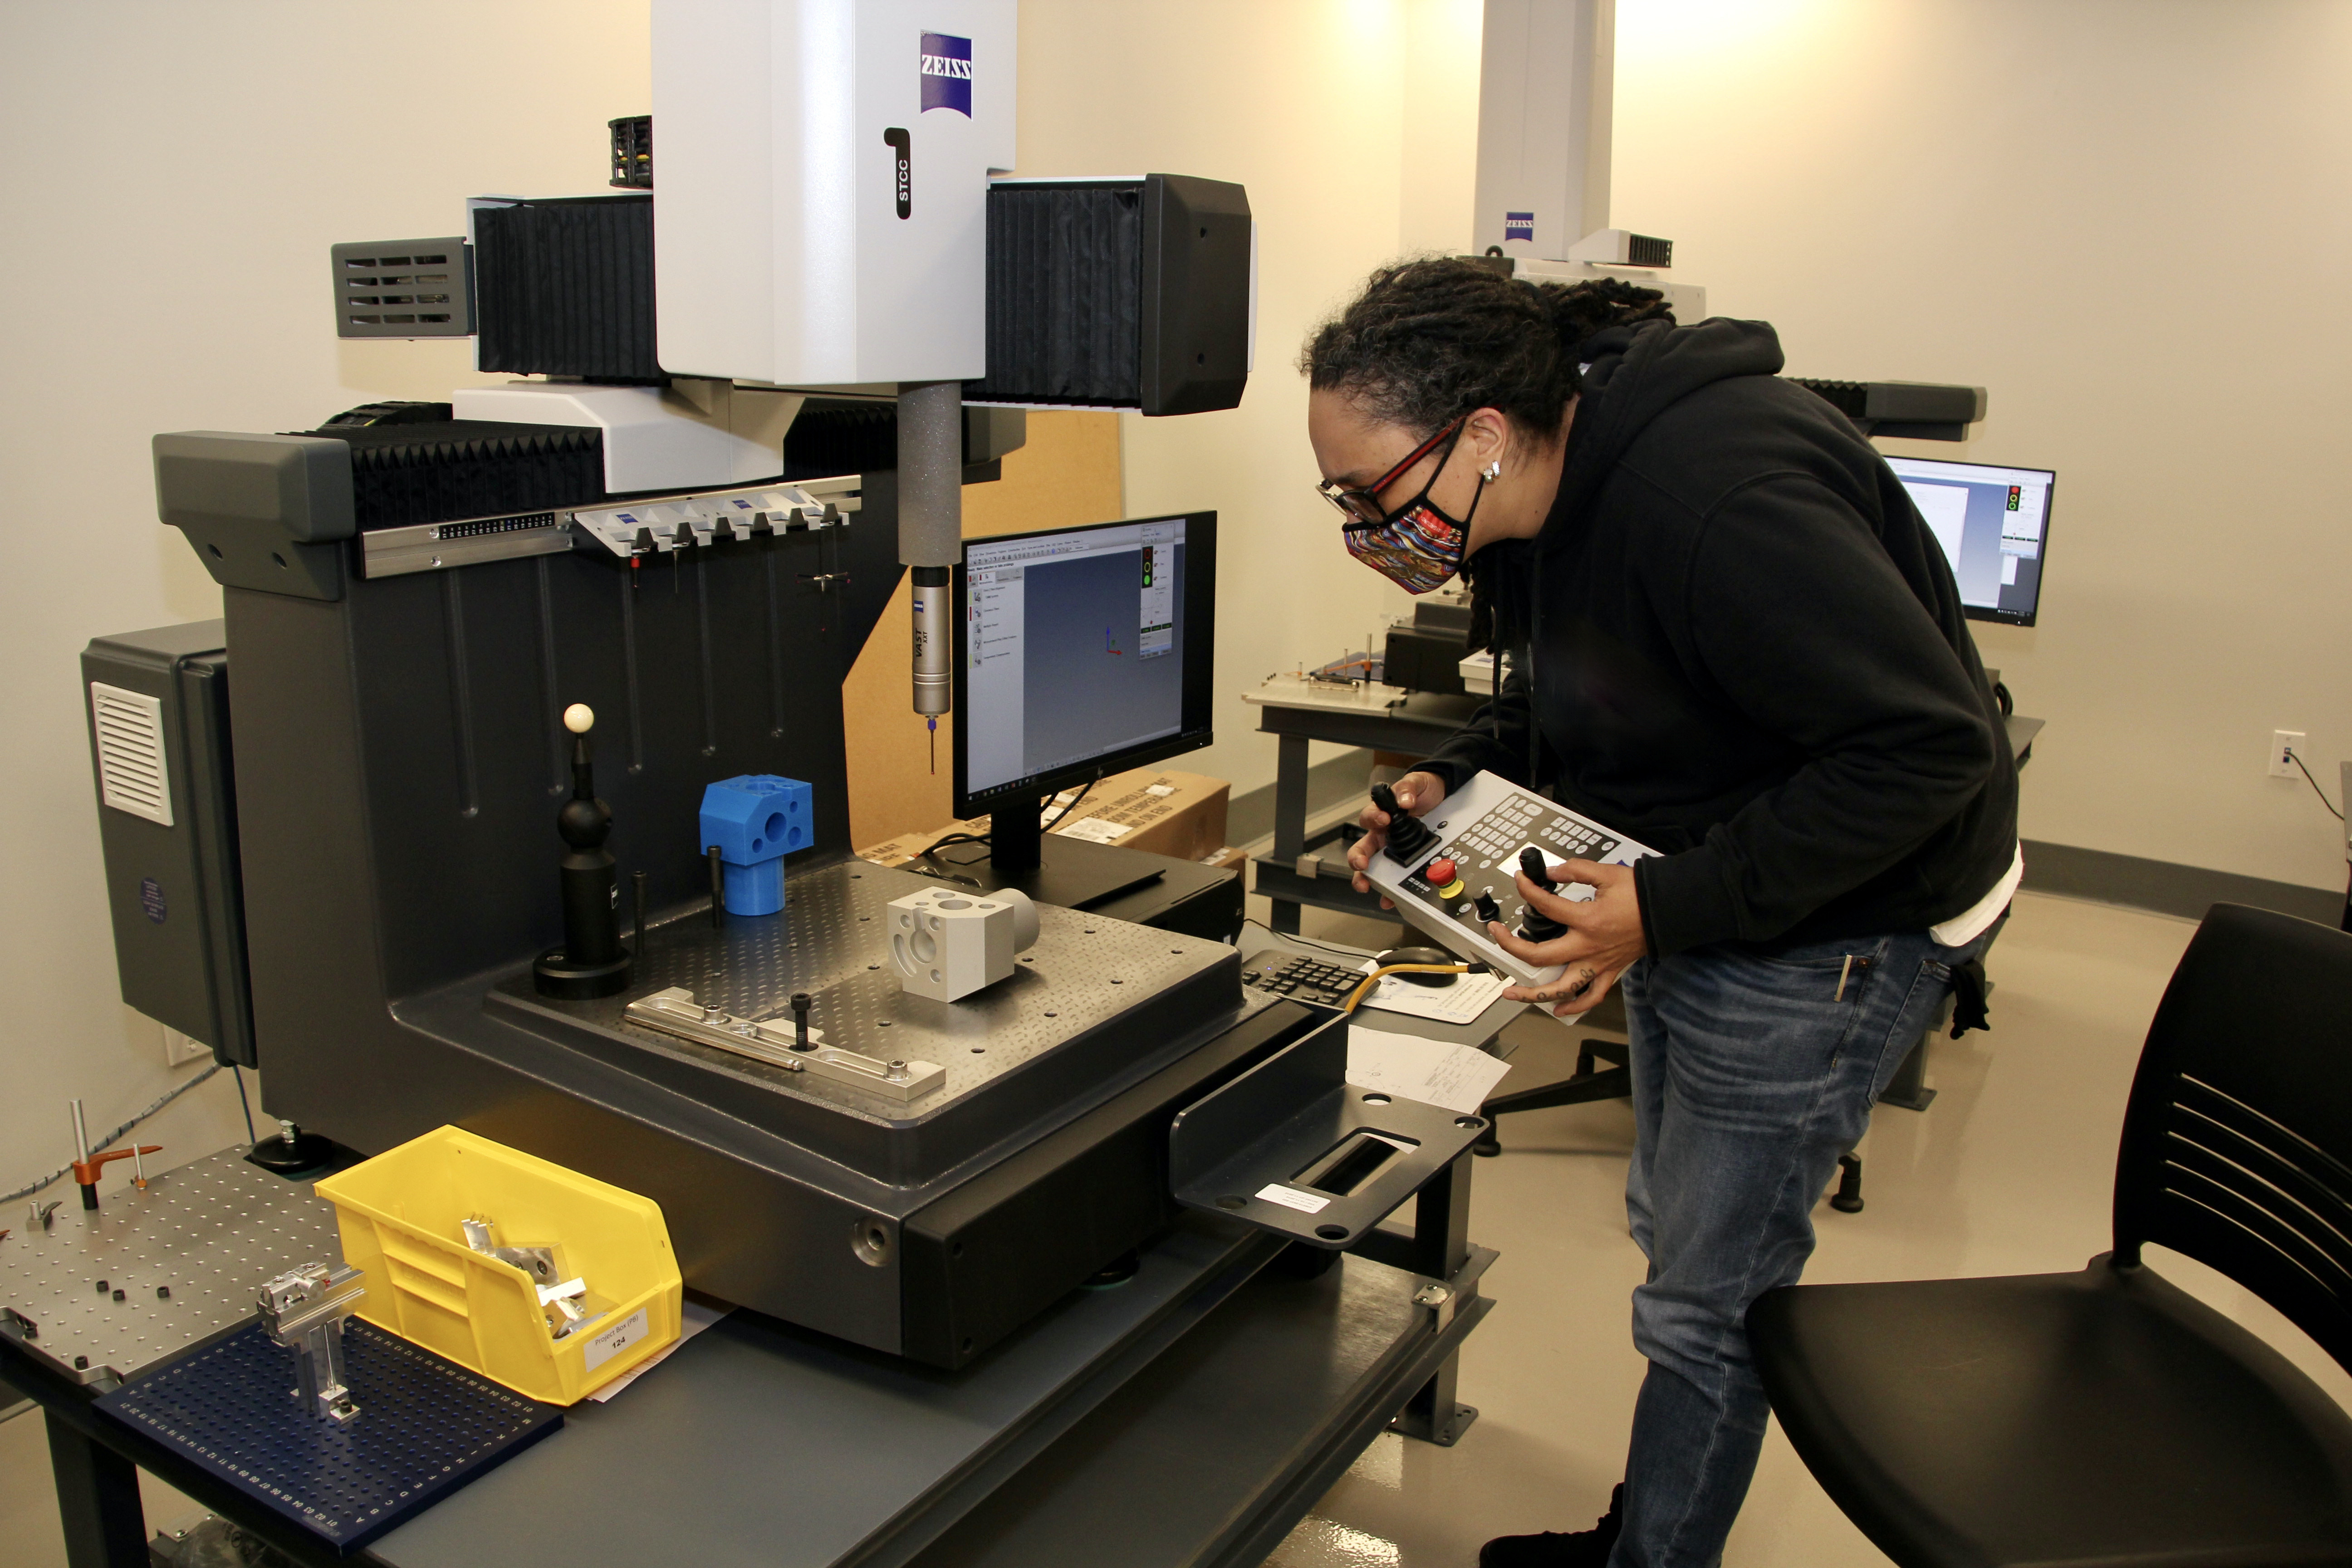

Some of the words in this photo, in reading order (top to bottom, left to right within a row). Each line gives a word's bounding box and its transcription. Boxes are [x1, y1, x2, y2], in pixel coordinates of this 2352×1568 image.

[921, 54, 971, 80] ZEISS
[899, 160, 908, 201] STCC
[595, 1331, 615, 1346] Project
[616, 1324, 626, 1333] Box
[627, 1314, 638, 1327] (PB)
[612, 1336, 625, 1348] 124
